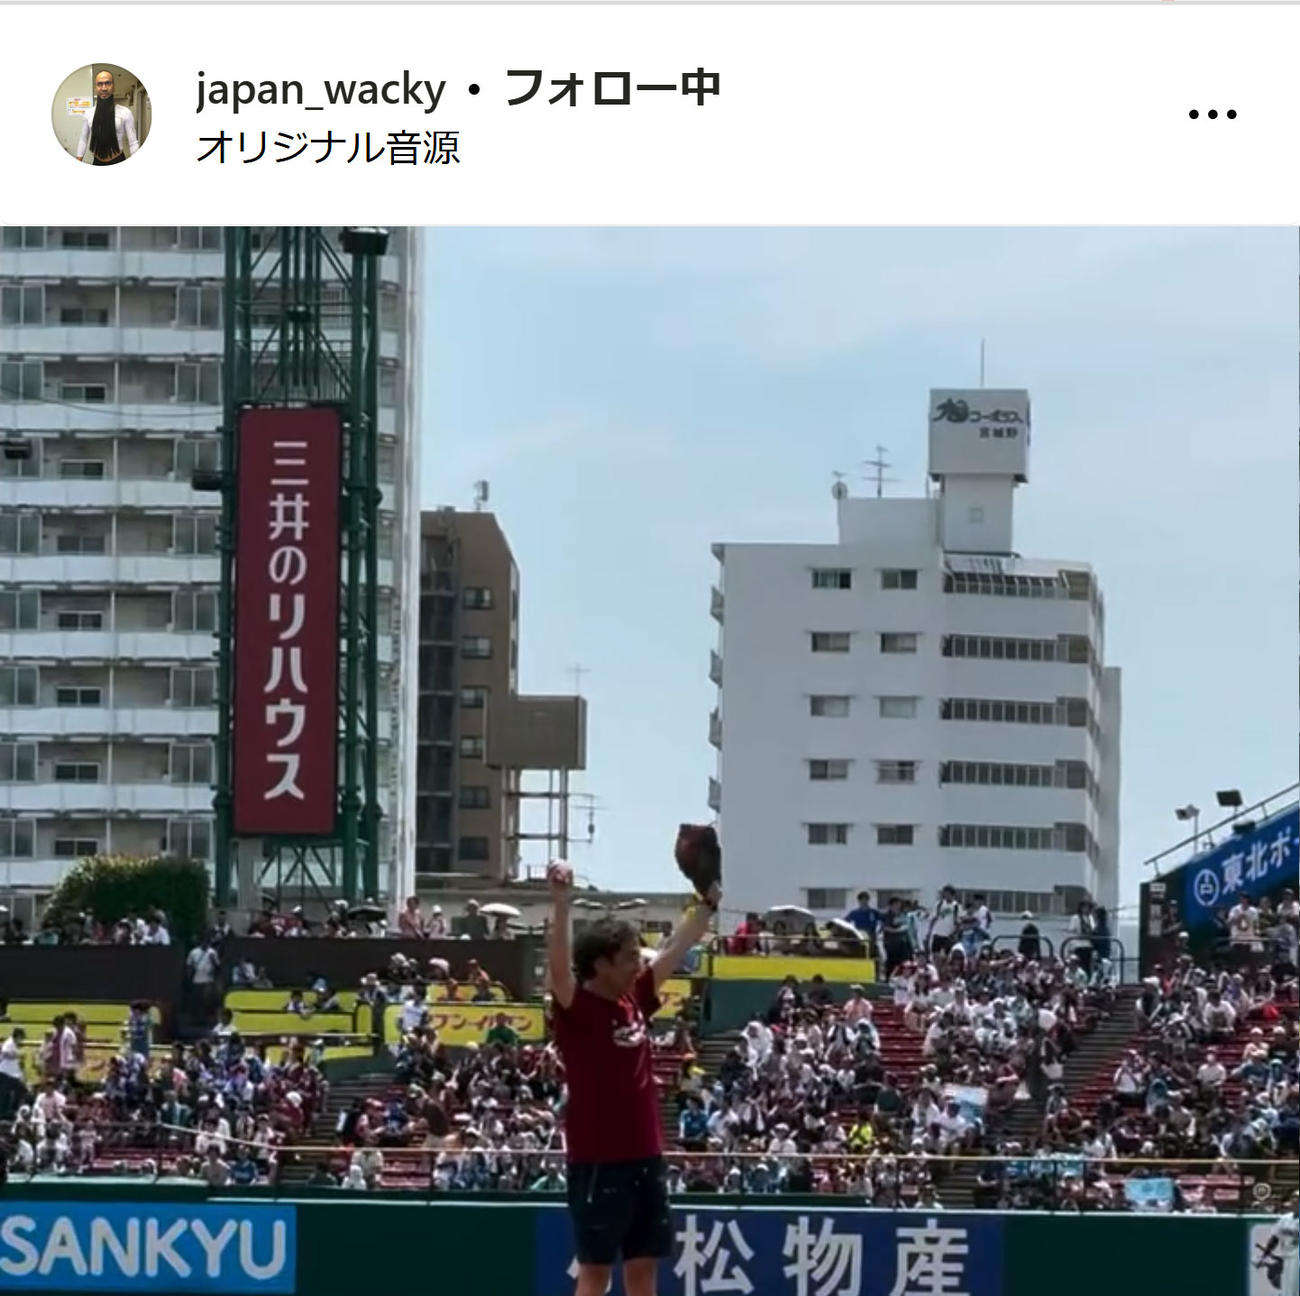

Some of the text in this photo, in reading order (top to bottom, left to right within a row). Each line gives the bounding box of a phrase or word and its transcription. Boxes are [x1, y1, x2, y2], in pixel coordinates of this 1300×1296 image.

[264, 441, 310, 800] 三井のリハウス
[1221, 826, 1299, 895] 東北ボ
[0, 1215, 287, 1280] SANKYU
